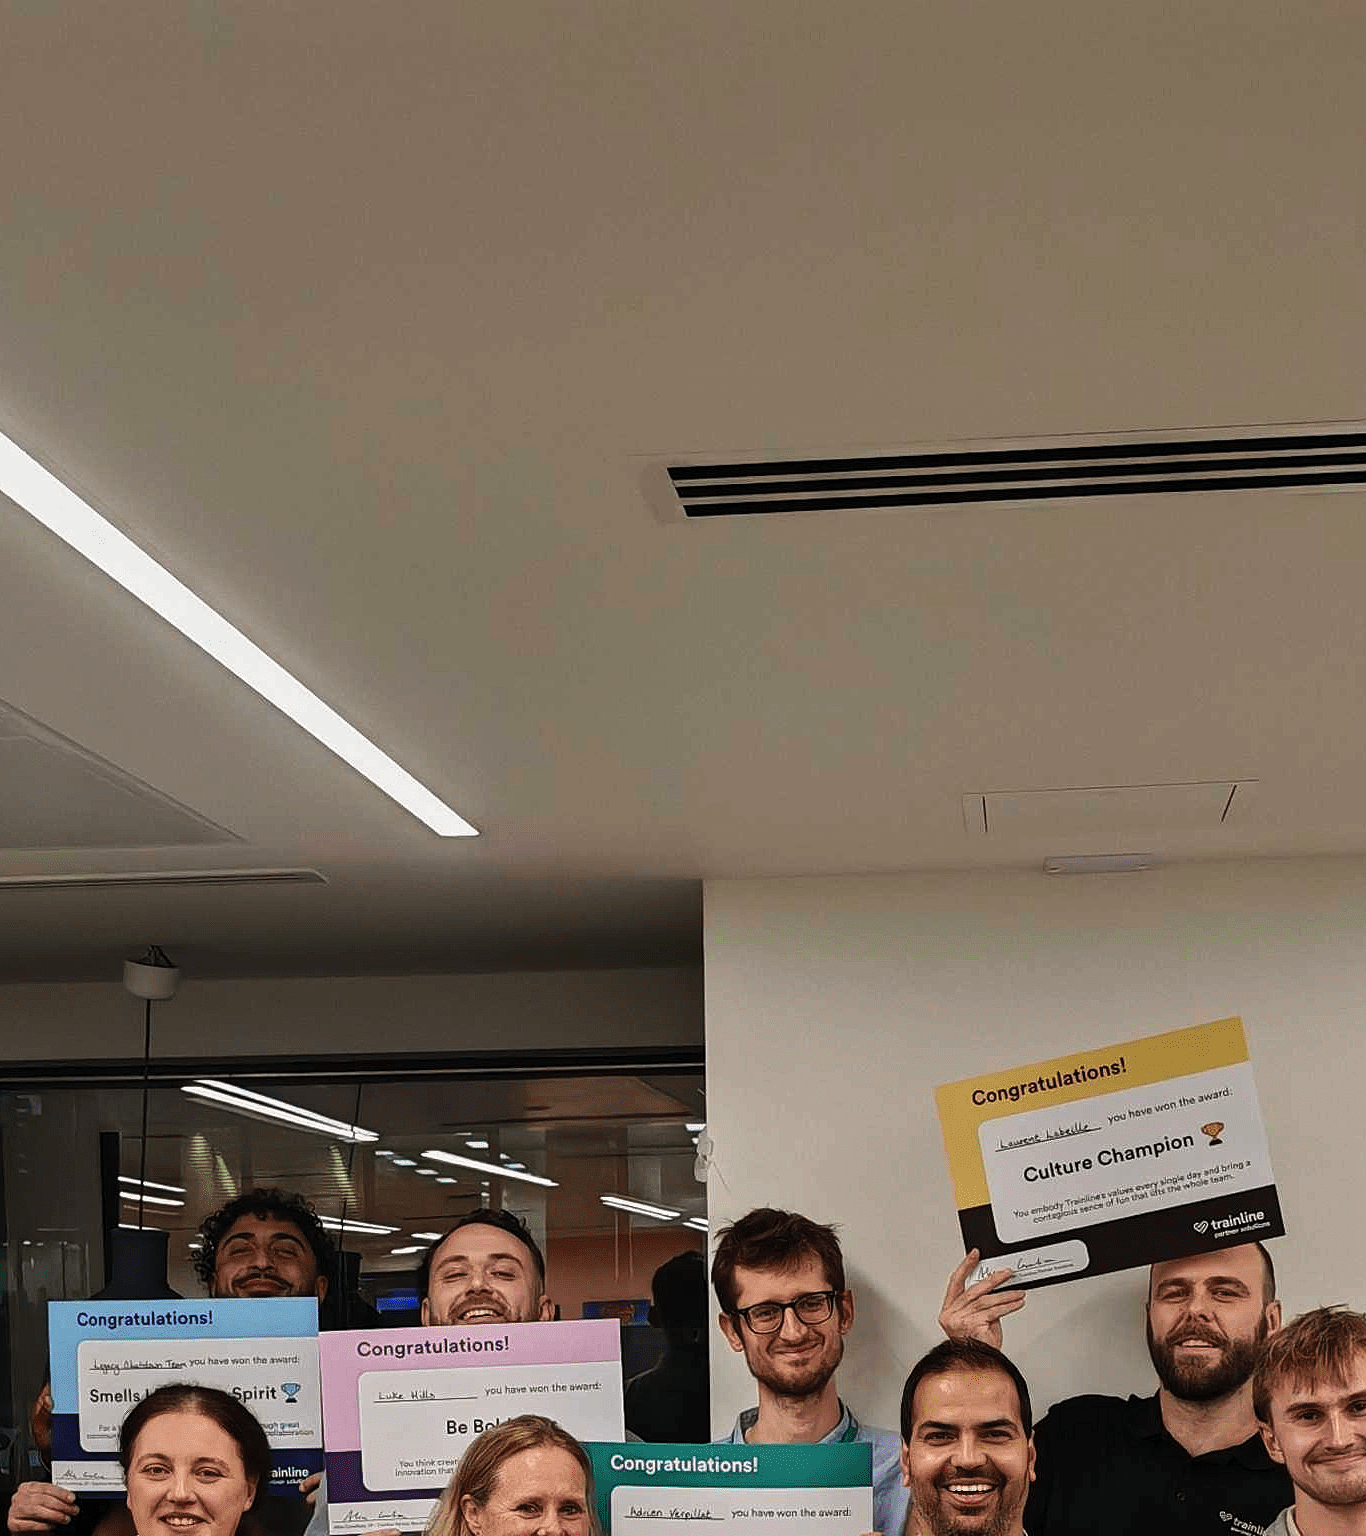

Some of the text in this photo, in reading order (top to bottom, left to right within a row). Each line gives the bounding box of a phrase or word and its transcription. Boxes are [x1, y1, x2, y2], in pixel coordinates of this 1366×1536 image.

[971, 1056, 1127, 1106] Congratulations!
[1107, 1087, 1233, 1125] you have won the award:
[1023, 1135, 1195, 1182] Culture Champion
[1210, 1211, 1265, 1230] trainline
[76, 1310, 213, 1330] Congratulations!
[356, 1335, 509, 1360] Congratulations!
[188, 1359, 206, 1367] you
[207, 1357, 230, 1365] have
[252, 1356, 268, 1365] the
[269, 1355, 300, 1365] award:
[89, 1388, 140, 1405] Smells
[232, 1385, 277, 1404] Spirit
[378, 1391, 404, 1400] Luke
[484, 1381, 602, 1397] you have won the award:
[446, 1417, 507, 1434] Be Bol
[271, 1466, 309, 1478] ainline
[610, 1454, 758, 1475] Congratulations!
[630, 1506, 663, 1517] Adrien
[731, 1506, 852, 1519] you have won the award:
[1233, 1517, 1265, 1536] trainli
